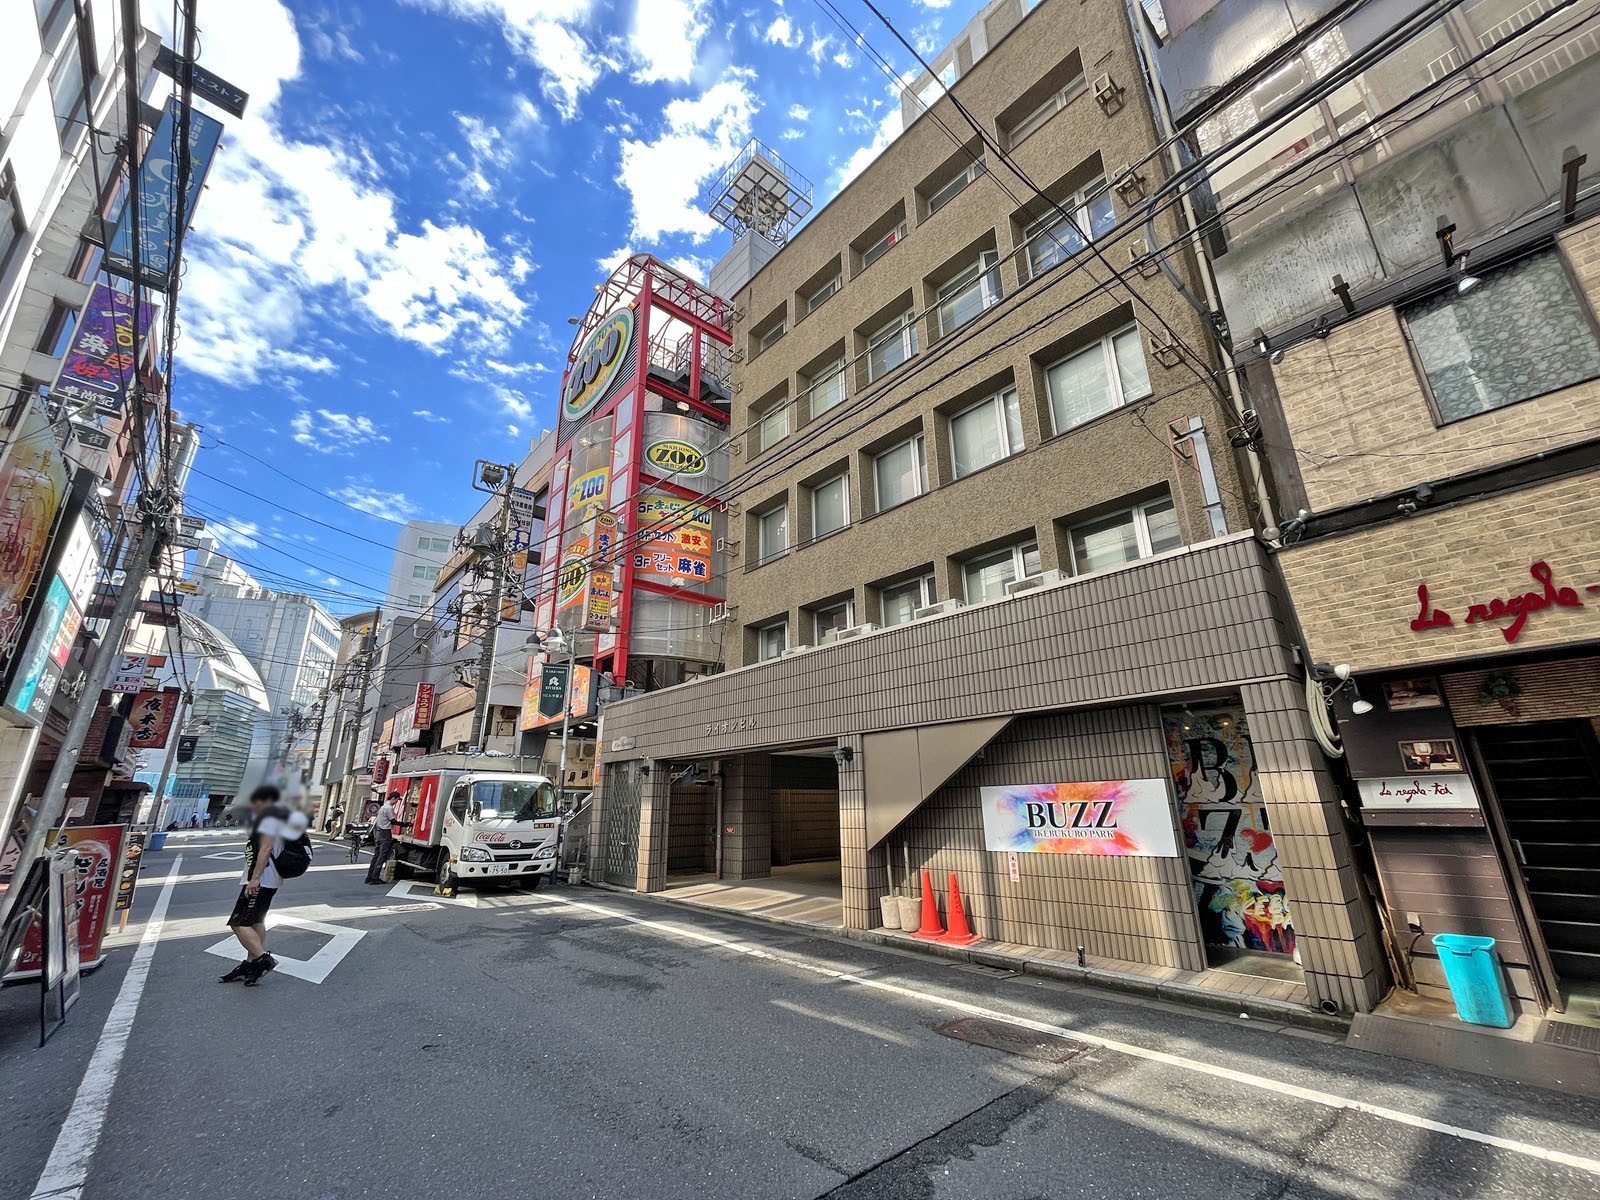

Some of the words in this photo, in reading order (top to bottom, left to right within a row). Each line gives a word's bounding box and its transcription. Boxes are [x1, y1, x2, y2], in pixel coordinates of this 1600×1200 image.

[579, 474, 606, 502] ZOO
[638, 501, 653, 513] 5F
[681, 533, 701, 546] 激安
[634, 555, 651, 568] 3F
[653, 553, 672, 562] フリー
[678, 557, 707, 577] 麻雀
[656, 563, 674, 572] セット
[706, 718, 757, 736] ライオンビル
[1025, 801, 1118, 829] BUZZ
[1034, 829, 1088, 838] IKEBUKURO
[1089, 829, 1114, 839] PARK
